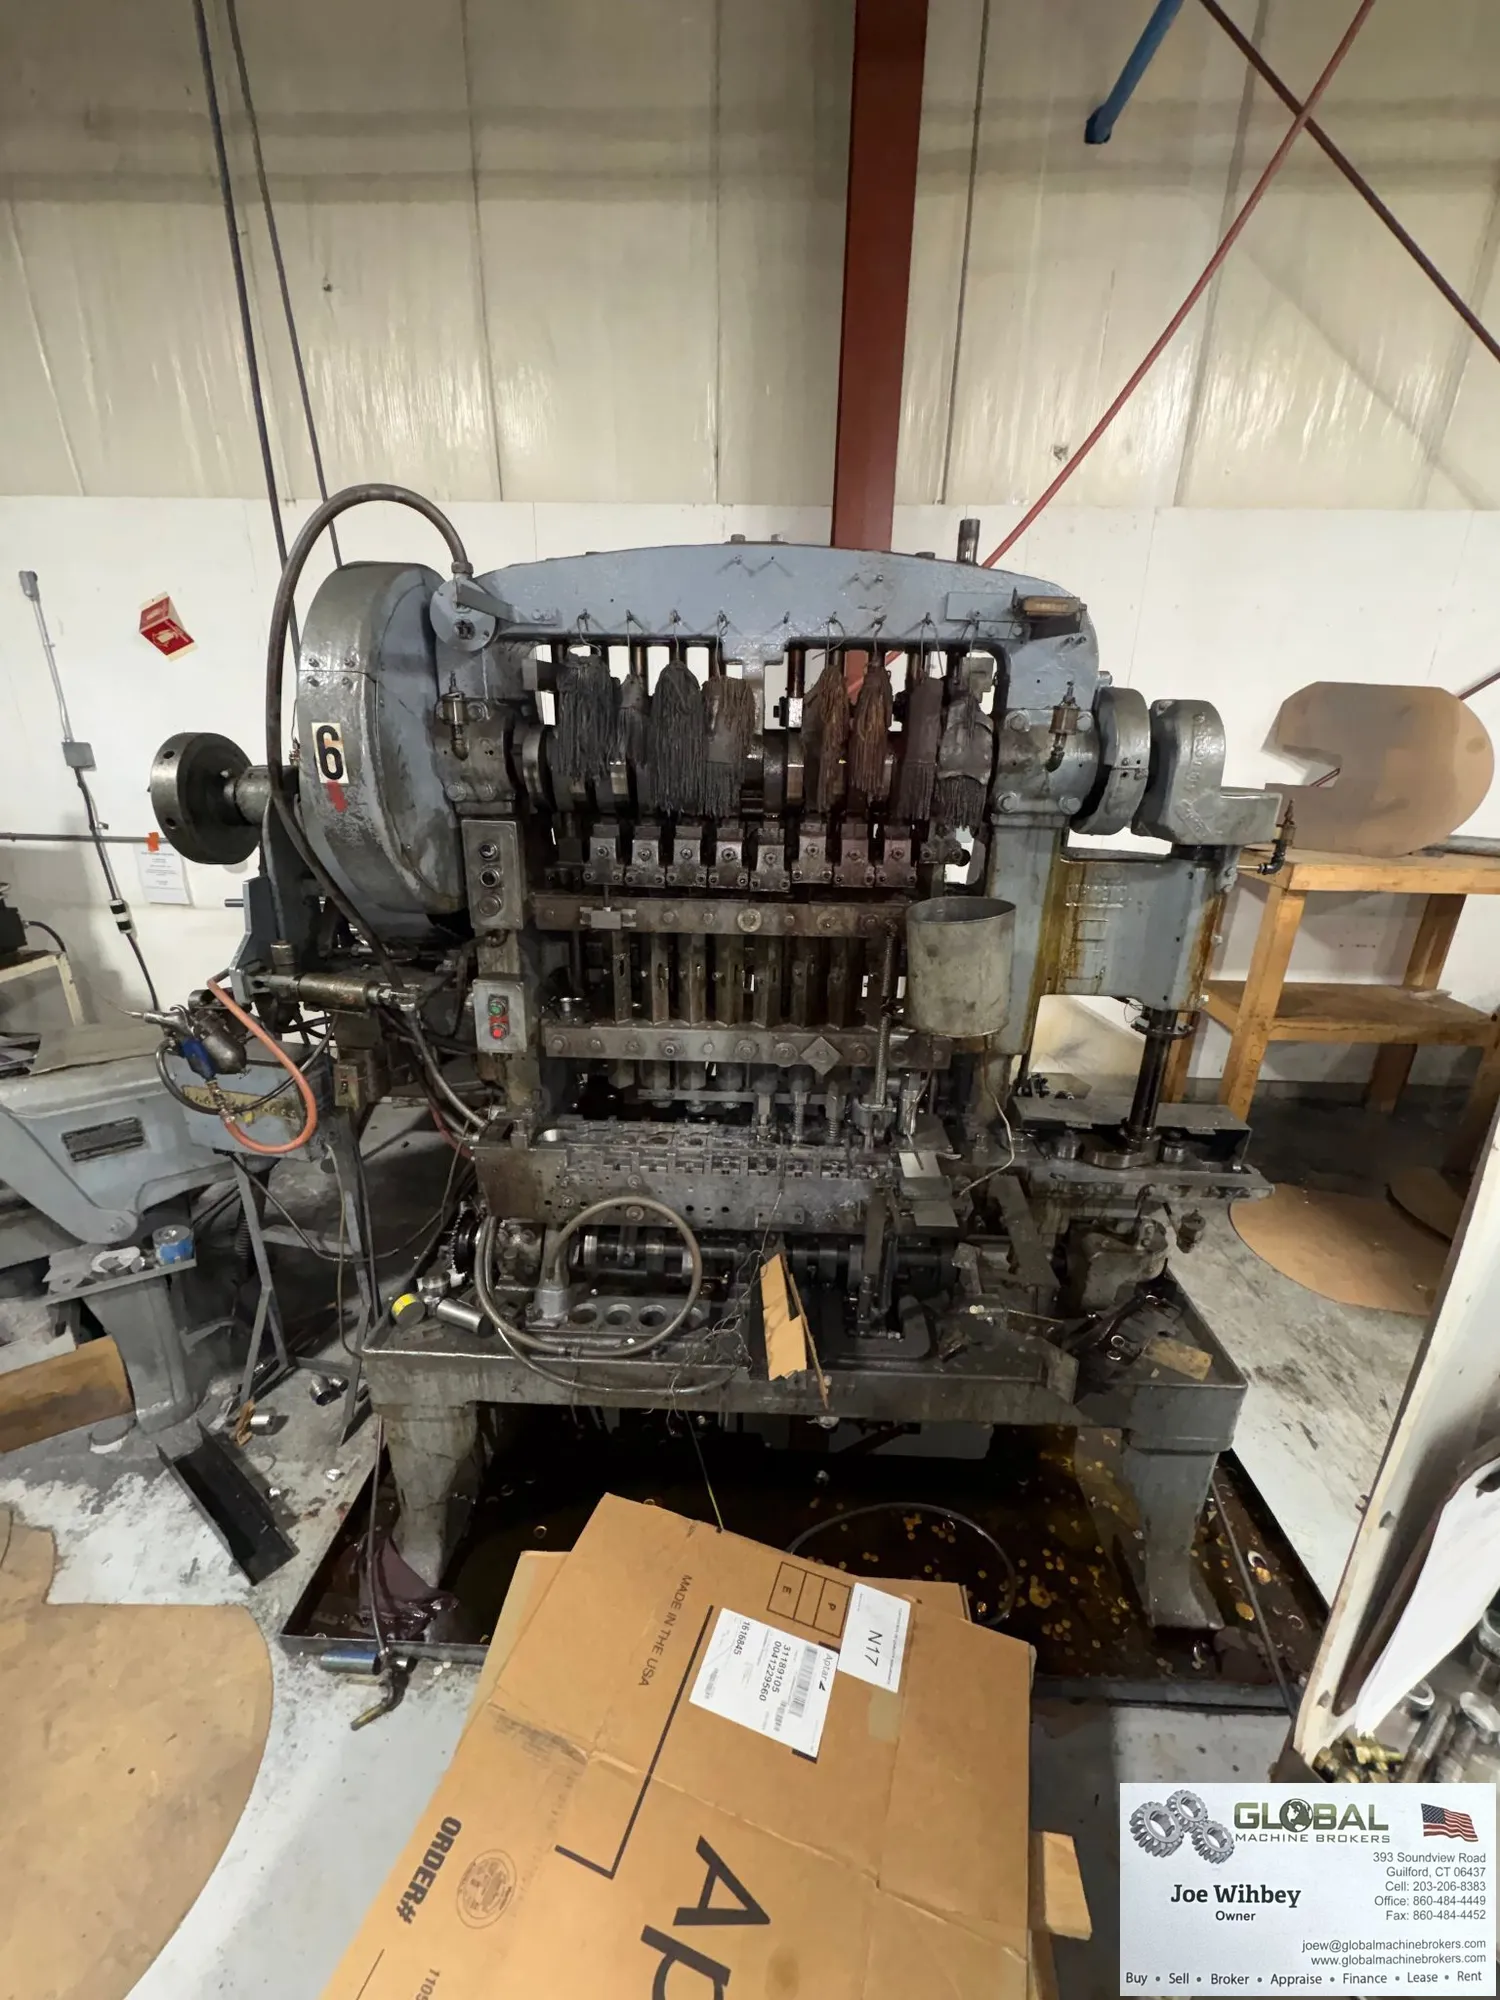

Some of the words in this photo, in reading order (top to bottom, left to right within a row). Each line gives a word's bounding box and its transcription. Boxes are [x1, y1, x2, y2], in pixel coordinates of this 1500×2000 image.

[316, 725, 343, 780] 6
[671, 1574, 693, 1610] MADE
[781, 1585, 792, 1595] E
[664, 1611, 678, 1627] IN
[827, 1601, 837, 1612] P
[651, 1628, 672, 1656] THE
[863, 1629, 883, 1668] N17
[638, 1657, 659, 1686] USA
[819, 1653, 834, 1682] Aptar
[396, 1816, 463, 1925] ORDER#
